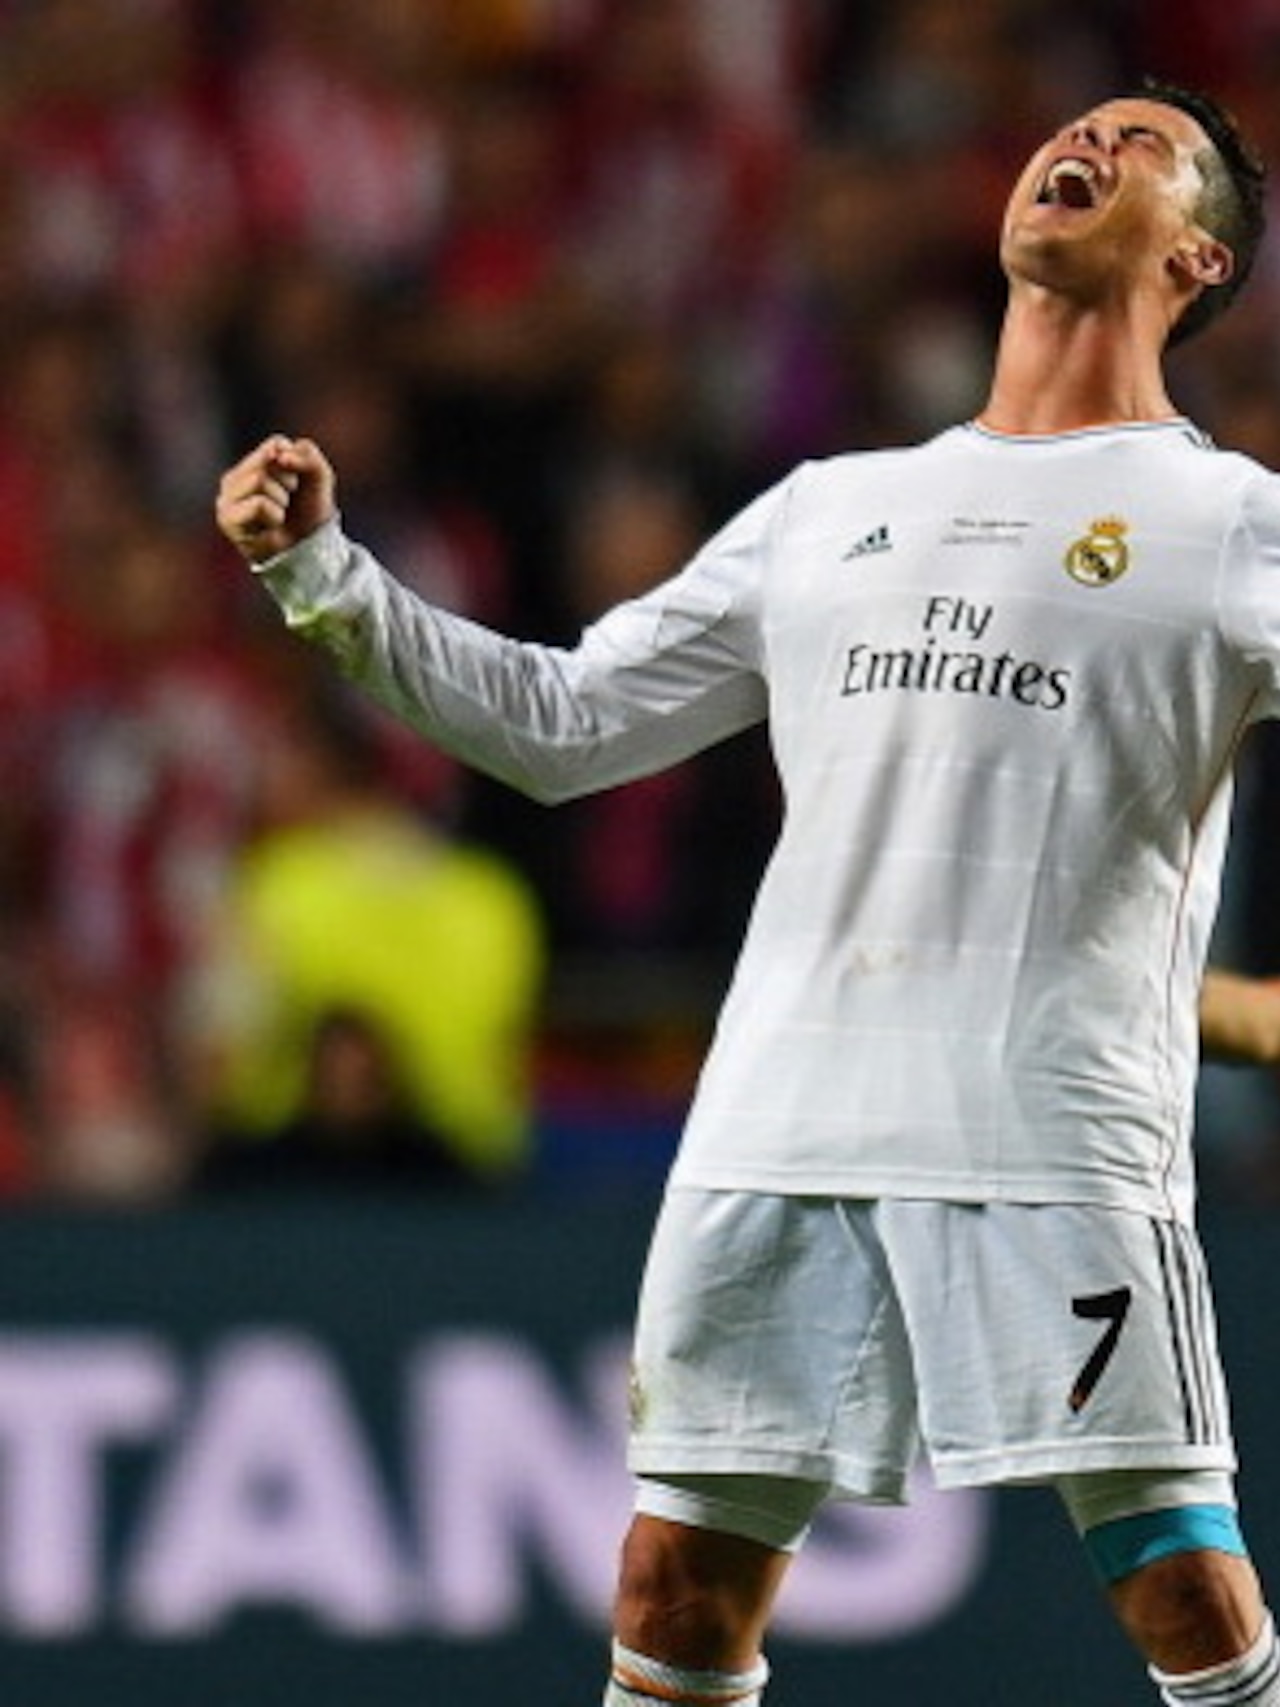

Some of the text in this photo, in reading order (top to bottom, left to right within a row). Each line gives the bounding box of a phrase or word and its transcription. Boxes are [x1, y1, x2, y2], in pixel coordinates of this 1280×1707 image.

[923, 596, 993, 639] Fly
[841, 638, 1070, 709] Emirates
[1067, 1286, 1131, 1415] 7
